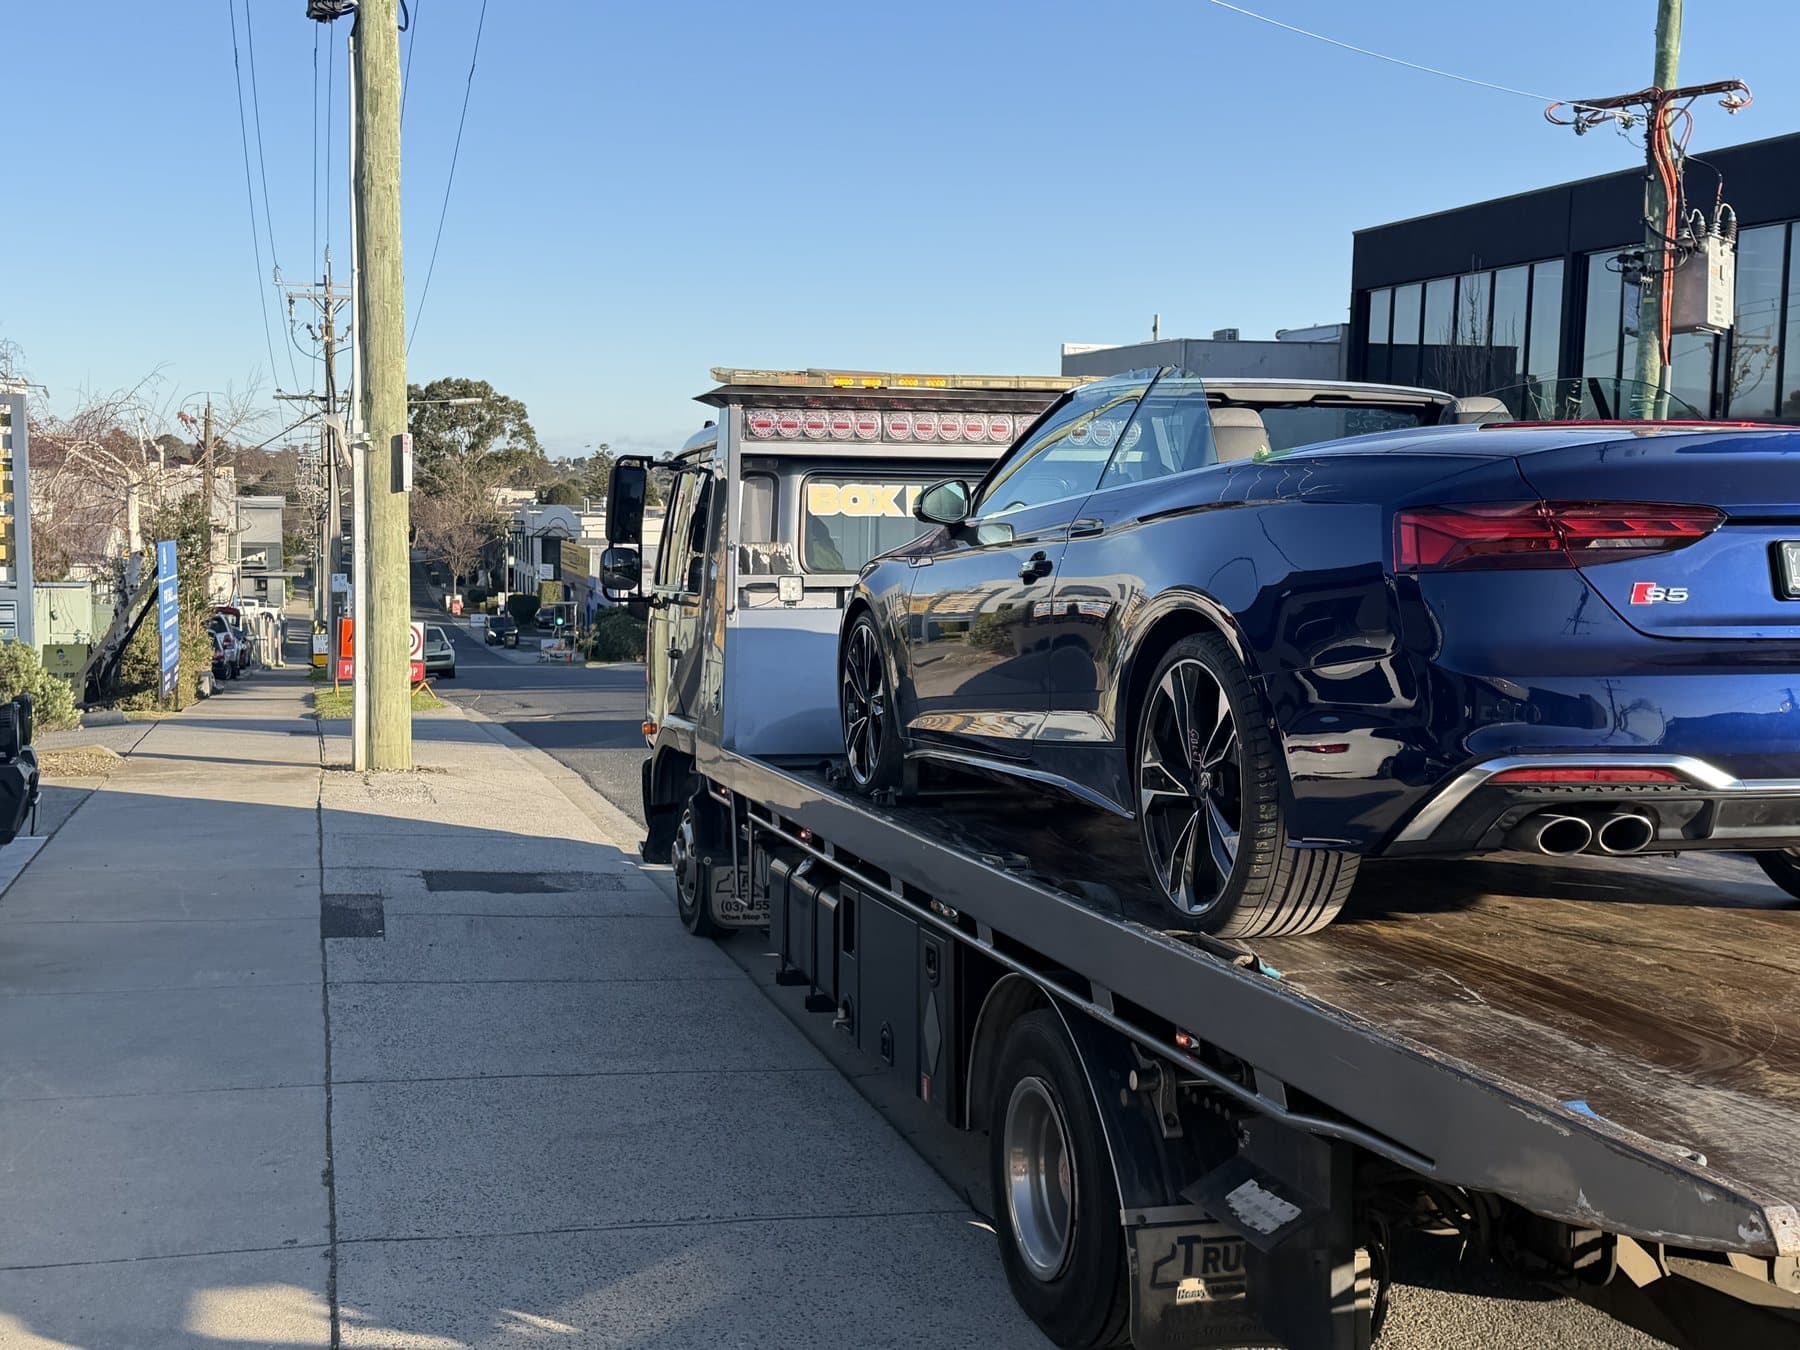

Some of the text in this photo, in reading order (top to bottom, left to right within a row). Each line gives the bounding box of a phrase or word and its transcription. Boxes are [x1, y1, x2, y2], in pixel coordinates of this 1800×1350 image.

[808, 484, 905, 516] BOX
[1645, 587, 1688, 603] S5
[1177, 1235, 1245, 1276] TRU
